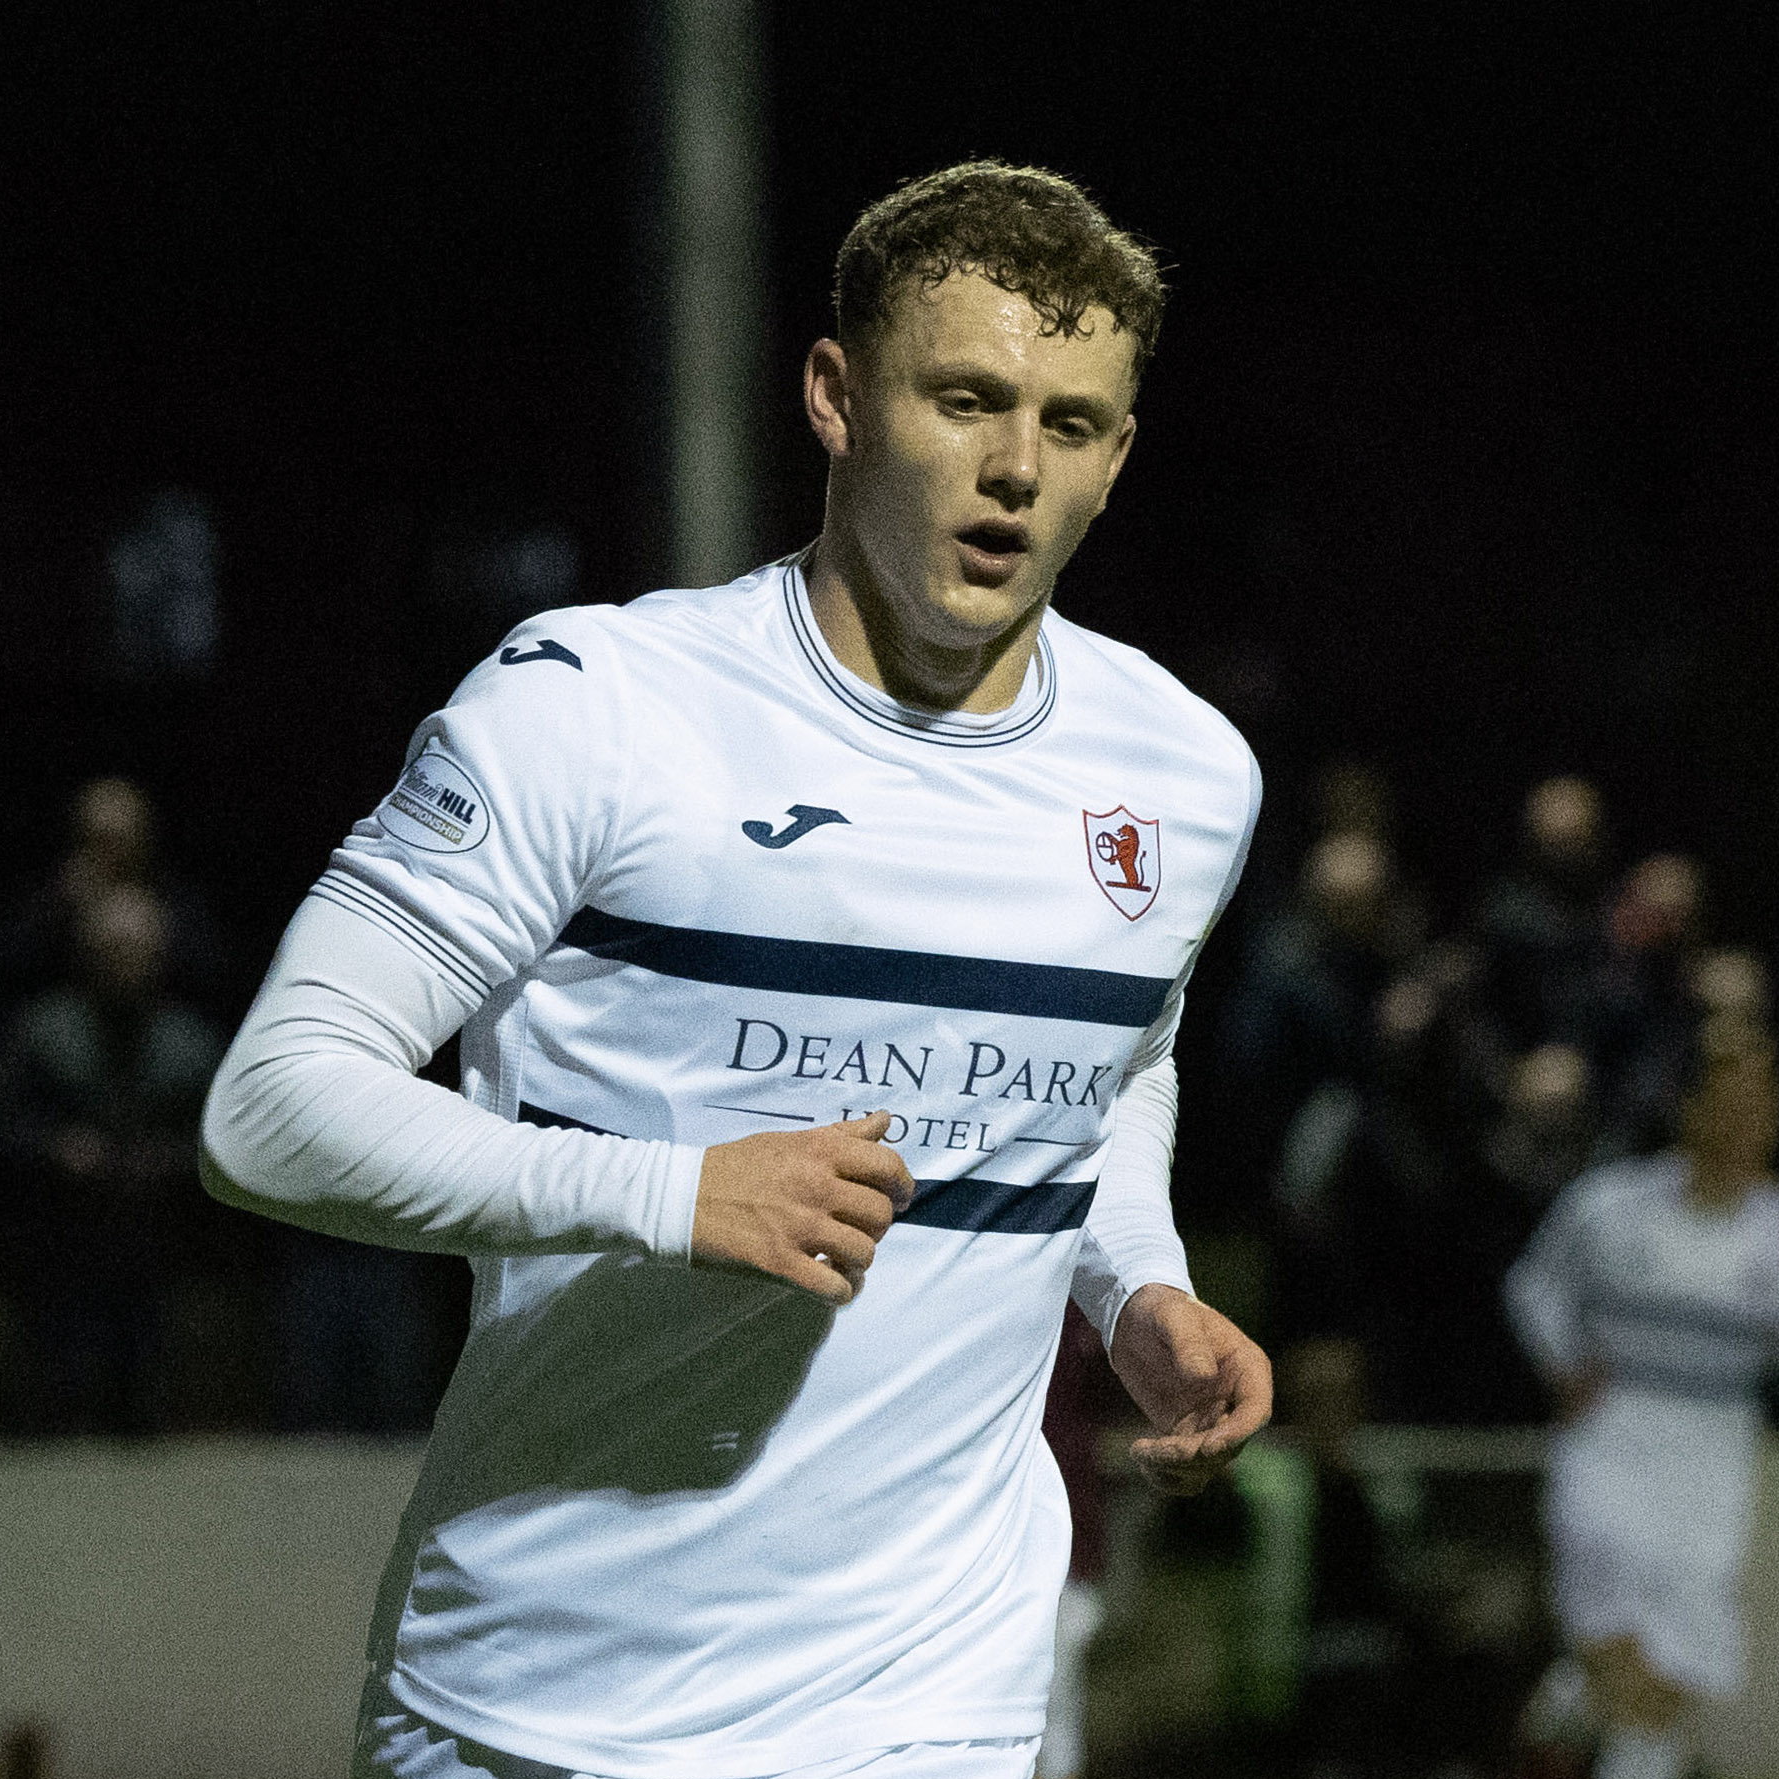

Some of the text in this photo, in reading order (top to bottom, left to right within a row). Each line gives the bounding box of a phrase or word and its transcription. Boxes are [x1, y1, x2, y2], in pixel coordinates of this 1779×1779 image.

[390, 792, 464, 841] CHAMPIONSHIP
[436, 787, 476, 825] HILL
[726, 1017, 1114, 1107] DEAN PARK
